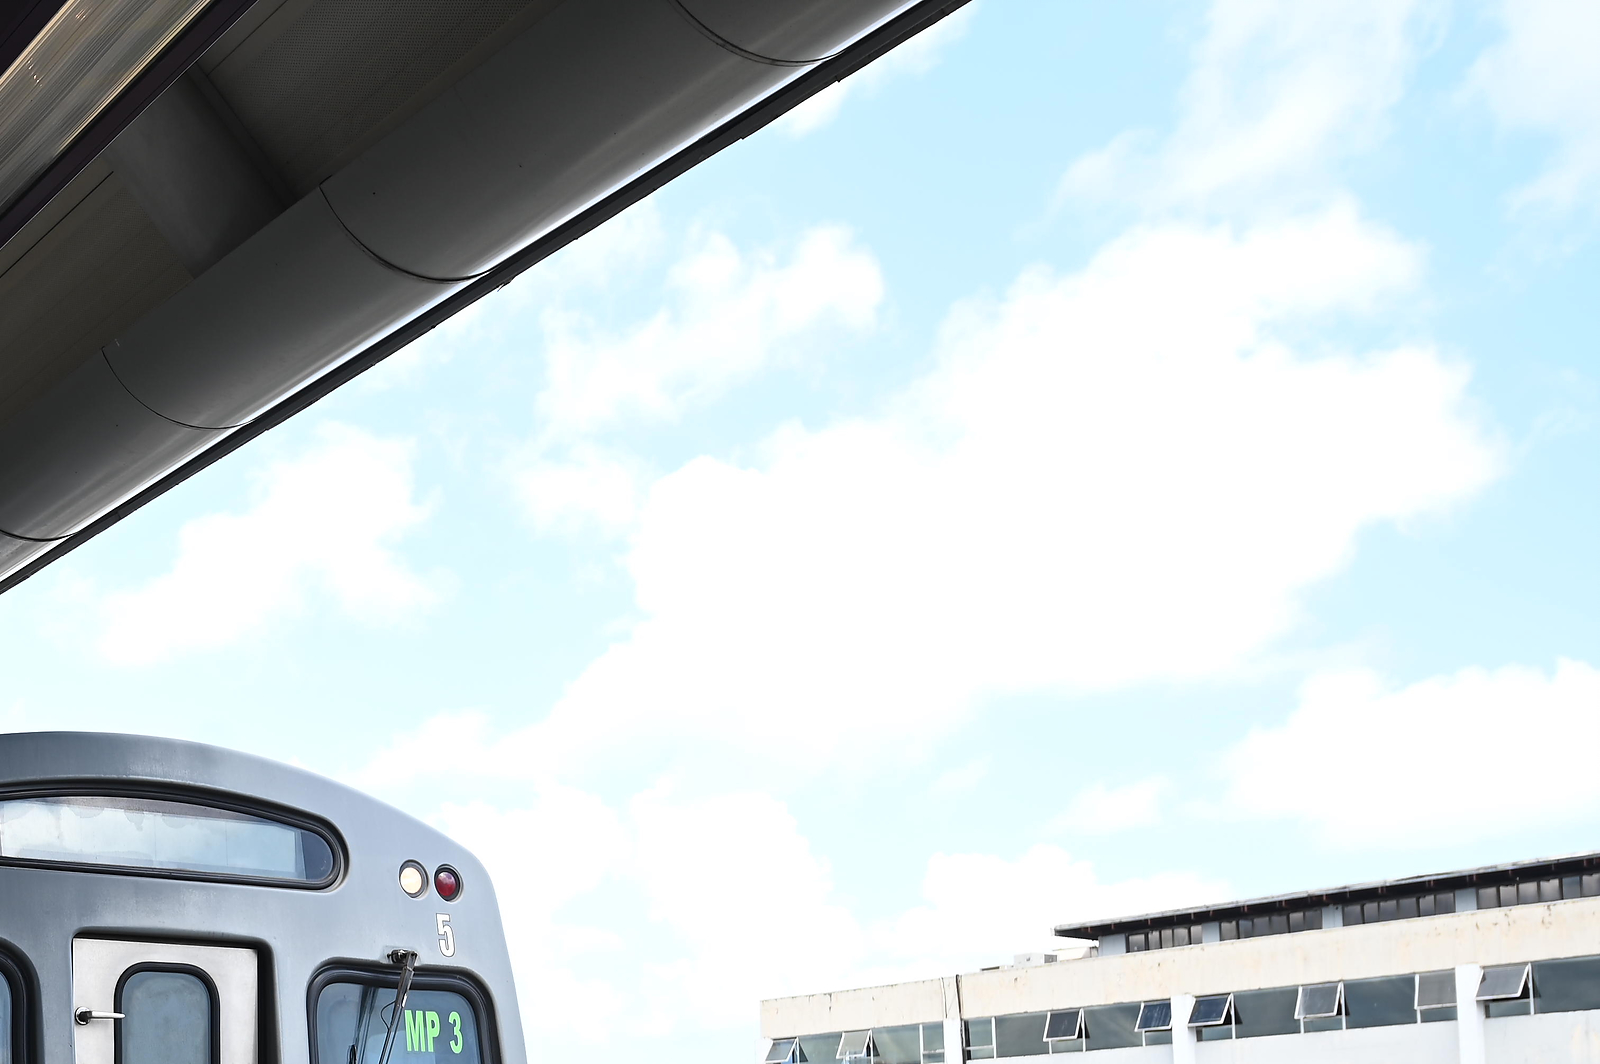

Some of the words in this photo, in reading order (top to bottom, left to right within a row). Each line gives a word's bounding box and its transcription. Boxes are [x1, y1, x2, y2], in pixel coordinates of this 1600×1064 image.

[436, 913, 456, 957] 5
[404, 1009, 440, 1053] MP
[448, 1011, 463, 1054] 3
